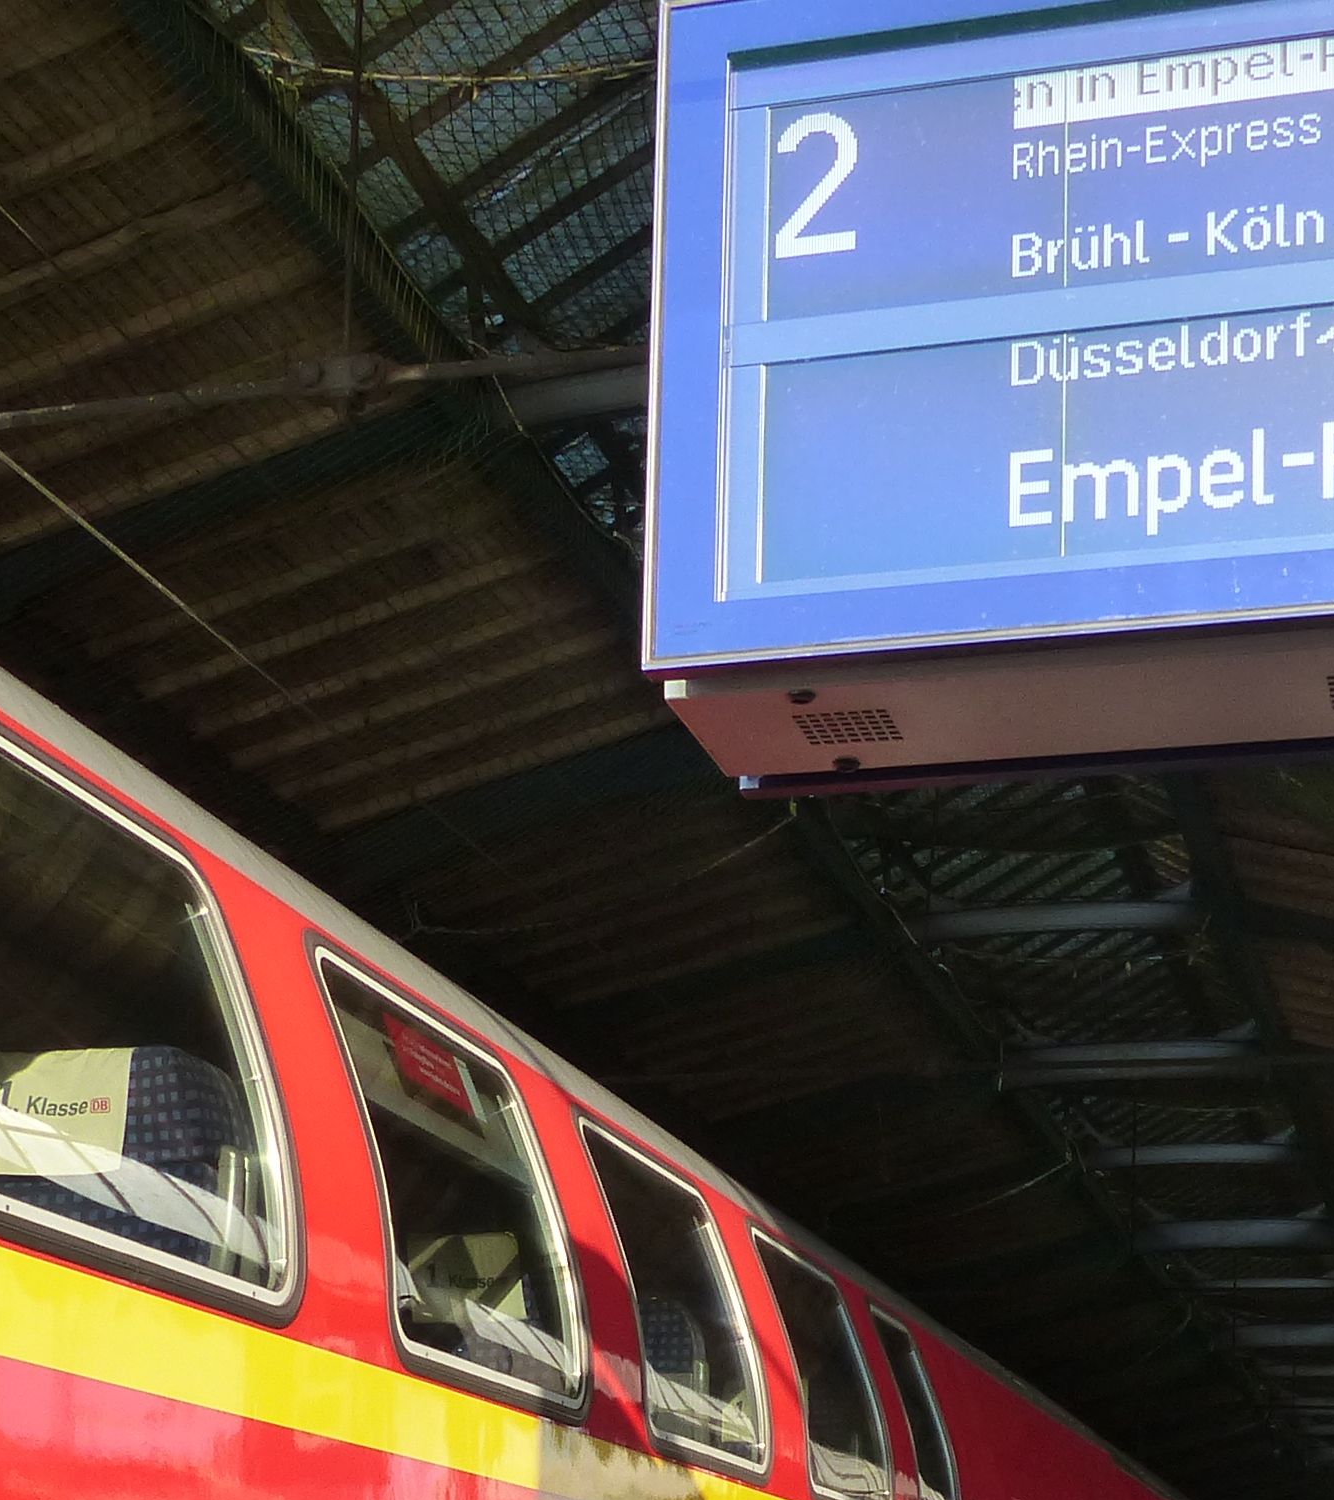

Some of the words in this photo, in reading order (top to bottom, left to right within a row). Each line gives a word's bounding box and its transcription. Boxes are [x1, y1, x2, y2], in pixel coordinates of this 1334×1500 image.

[1076, 69, 1116, 103] in
[1012, 113, 1322, 180] Rhein-Express
[774, 111, 860, 260] 2
[1011, 219, 1150, 279] Brühl
[1205, 204, 1324, 256] Köln
[1011, 313, 1312, 387] Düsseldorf
[27, 1096, 88, 1117] Klasse
